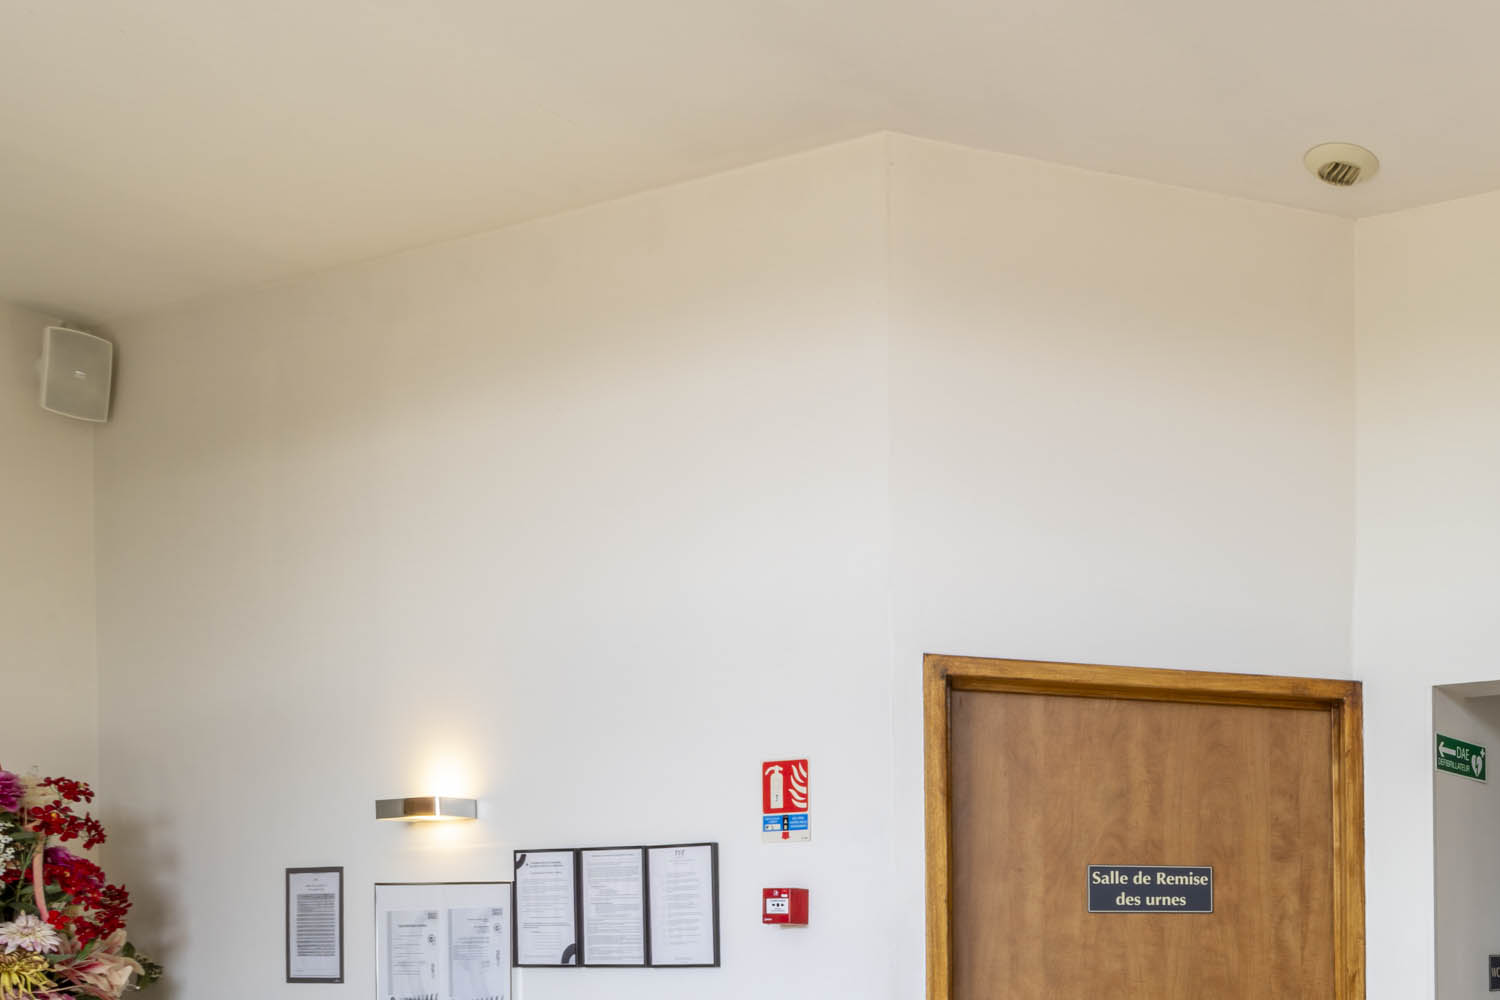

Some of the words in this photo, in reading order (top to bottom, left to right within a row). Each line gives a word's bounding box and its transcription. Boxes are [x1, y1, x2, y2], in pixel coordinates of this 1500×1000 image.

[1456, 746, 1470, 761] DAE
[1092, 870, 1129, 885] Salle
[1132, 871, 1151, 885] de
[1156, 872, 1209, 886] Remise
[1115, 891, 1141, 906] des
[1145, 895, 1187, 906] urnes
